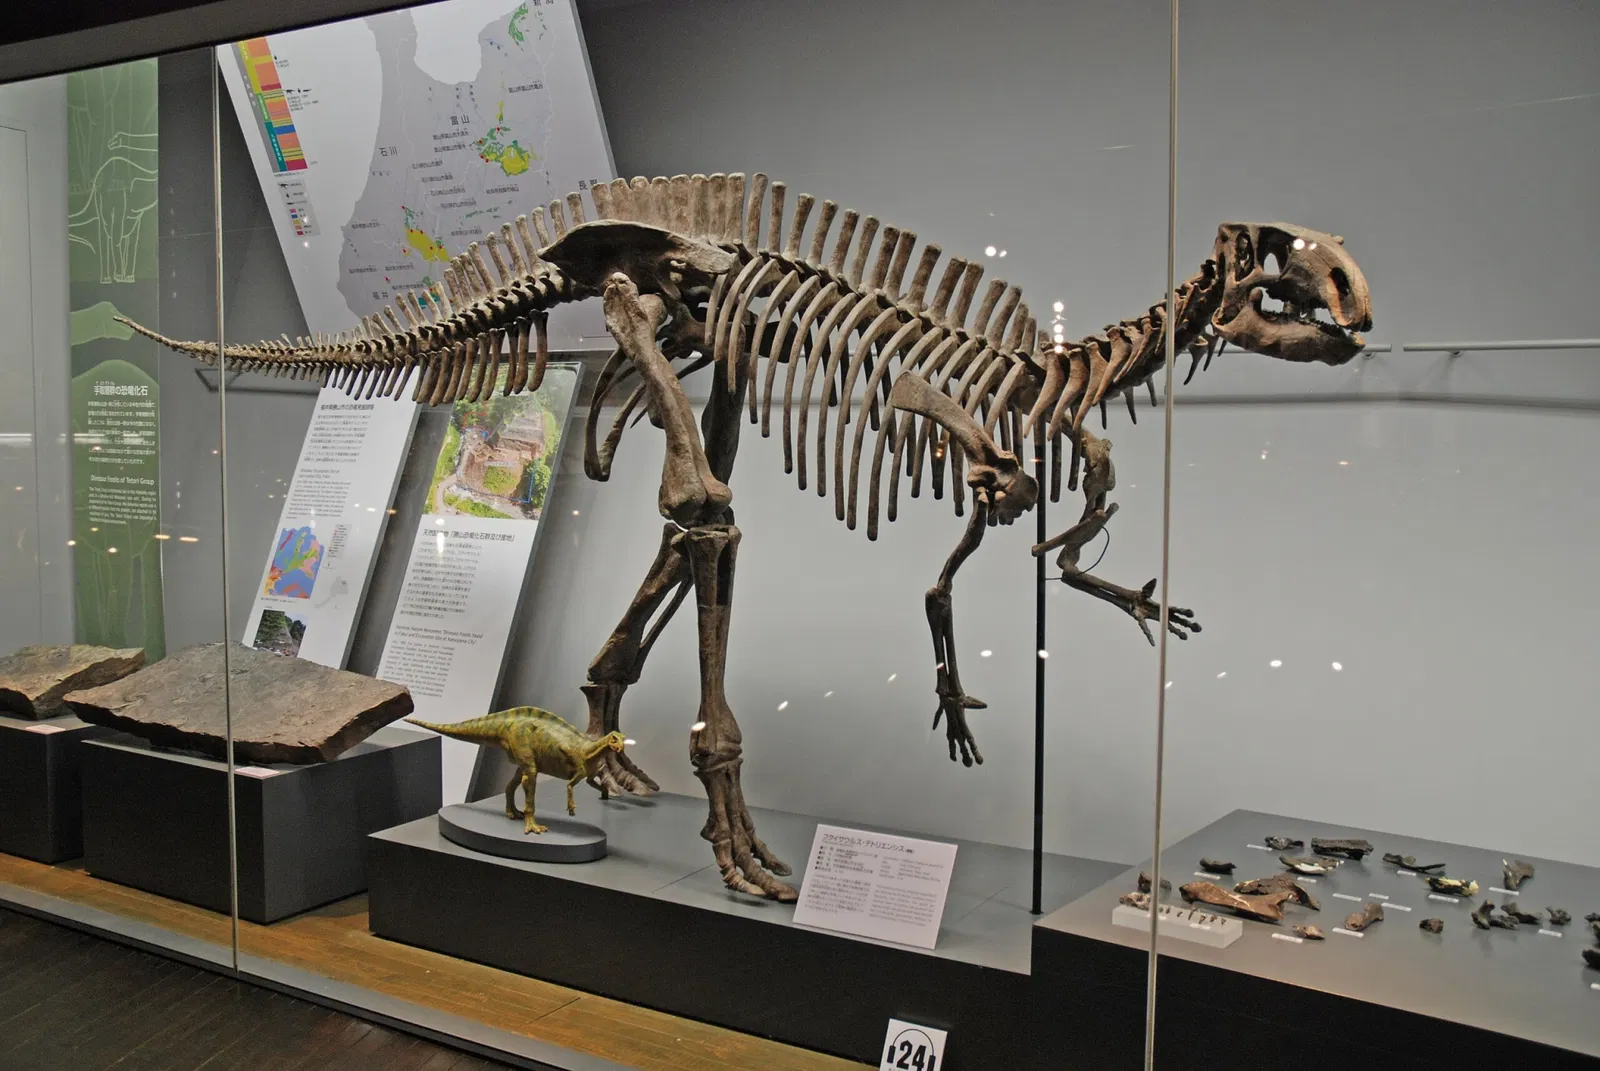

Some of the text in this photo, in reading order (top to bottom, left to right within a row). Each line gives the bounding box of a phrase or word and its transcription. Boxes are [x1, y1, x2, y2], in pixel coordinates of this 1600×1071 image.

[450, 114, 470, 125] 富山
[378, 146, 398, 157] 石川
[140, 477, 155, 486] Group
[823, 833, 905, 852] フクイサウルス・テトリエンシス
[896, 1039, 927, 1071] 24
